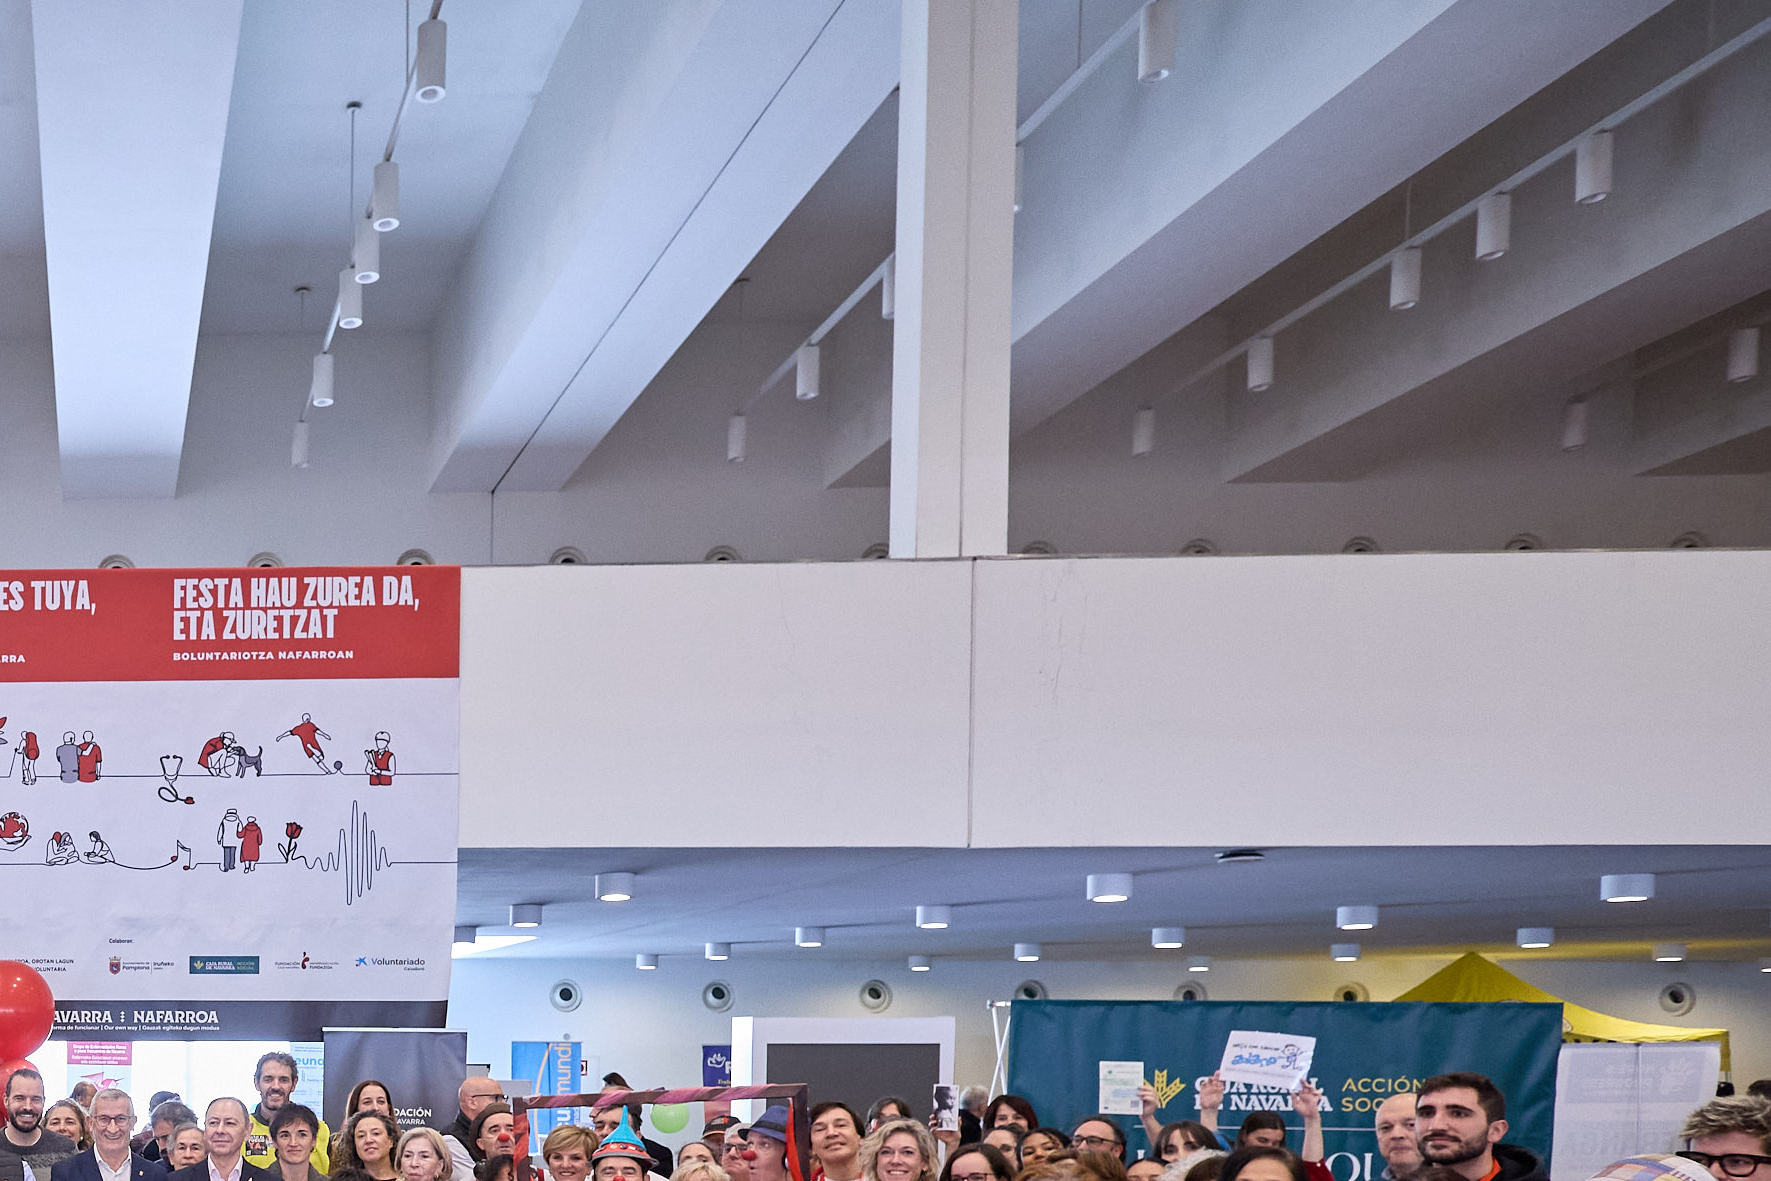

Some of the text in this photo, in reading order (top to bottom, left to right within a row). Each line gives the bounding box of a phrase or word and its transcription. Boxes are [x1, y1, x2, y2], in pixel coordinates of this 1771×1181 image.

[31, 580, 97, 616] TUYA,
[173, 575, 419, 611] FESTA HAU ZUREA DA,
[173, 608, 339, 640] ETA ZURETZAT
[173, 650, 354, 661] BOLUNTARIOTZA NAFARROAN
[371, 957, 426, 966] Voluntariado
[54, 1010, 219, 1024] AVARRA NAFARROA
[393, 1106, 432, 1118] DACIÓN
[1341, 1096, 1385, 1113] SOC
